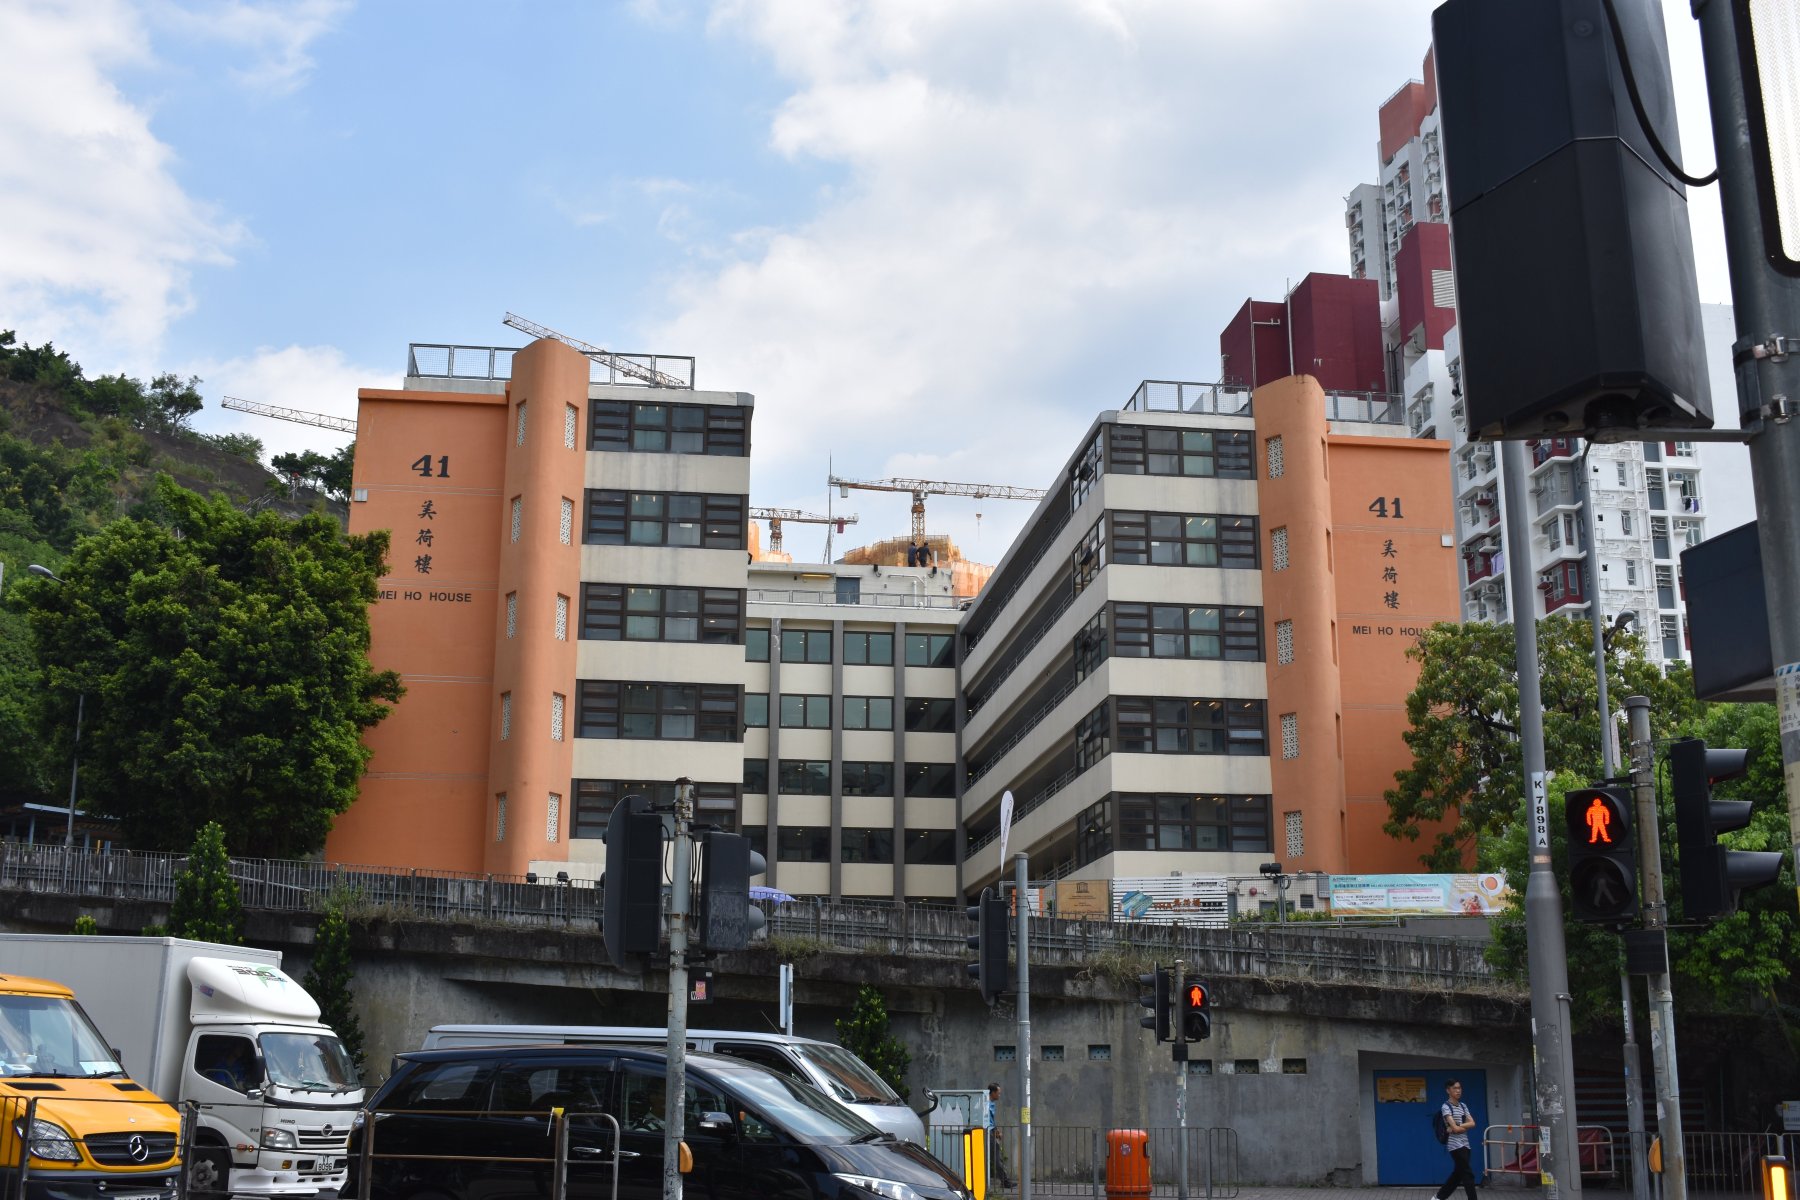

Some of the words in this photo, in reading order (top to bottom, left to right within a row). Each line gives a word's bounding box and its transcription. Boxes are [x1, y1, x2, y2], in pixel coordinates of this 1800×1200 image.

[411, 454, 450, 478] 41
[1368, 496, 1404, 519] 41
[414, 500, 438, 574] 美荷樓
[1381, 539, 1400, 610] 美荷樓
[376, 590, 397, 600] MEI
[404, 590, 422, 601] HO
[429, 591, 472, 602] HOUSE
[1352, 625, 1371, 635] MEI
[1378, 626, 1394, 636] HO
[1400, 627, 1422, 637] HOU
[1534, 780, 1542, 789] K
[1536, 796, 1545, 834] 7898
[1539, 837, 1546, 846] A
